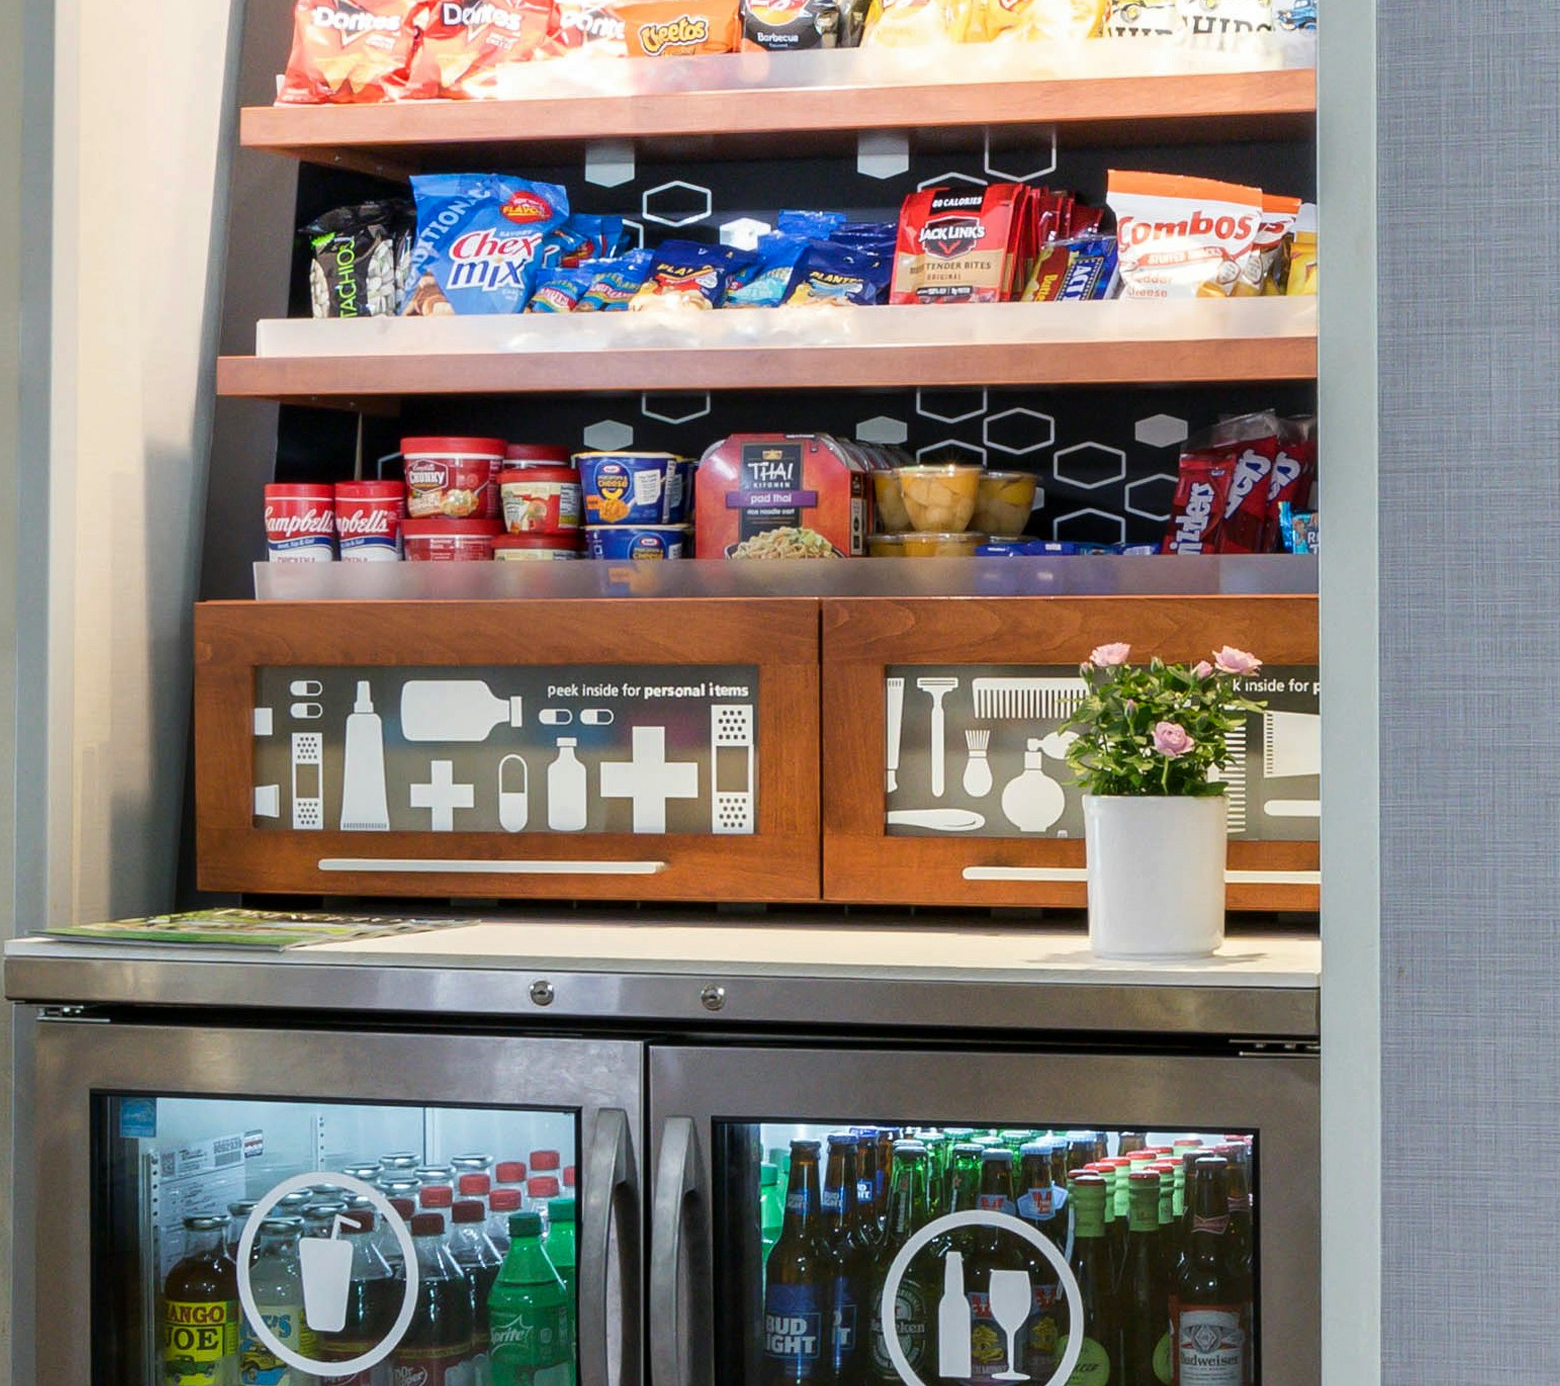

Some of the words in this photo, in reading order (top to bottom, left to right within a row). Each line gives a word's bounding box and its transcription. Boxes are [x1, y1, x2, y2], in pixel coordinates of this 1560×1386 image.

[312, 3, 402, 32] Doritos
[442, 1, 522, 33] Doritos
[639, 15, 708, 54] Cheetos
[944, 196, 983, 206] CALORIES
[919, 227, 948, 243] JACK
[1117, 210, 1253, 253] Combos
[452, 229, 542, 260] Chex
[450, 258, 526, 289] mix
[925, 262, 963, 271] TENDER
[964, 261, 991, 271] BITES
[747, 461, 793, 481] THAI
[750, 493, 770, 505] pad
[547, 682, 579, 699] peek
[582, 682, 619, 698] inside
[622, 682, 641, 698] for
[643, 681, 706, 700] personal
[709, 682, 750, 698] items
[1245, 678, 1285, 693] inside
[1288, 677, 1310, 693] for
